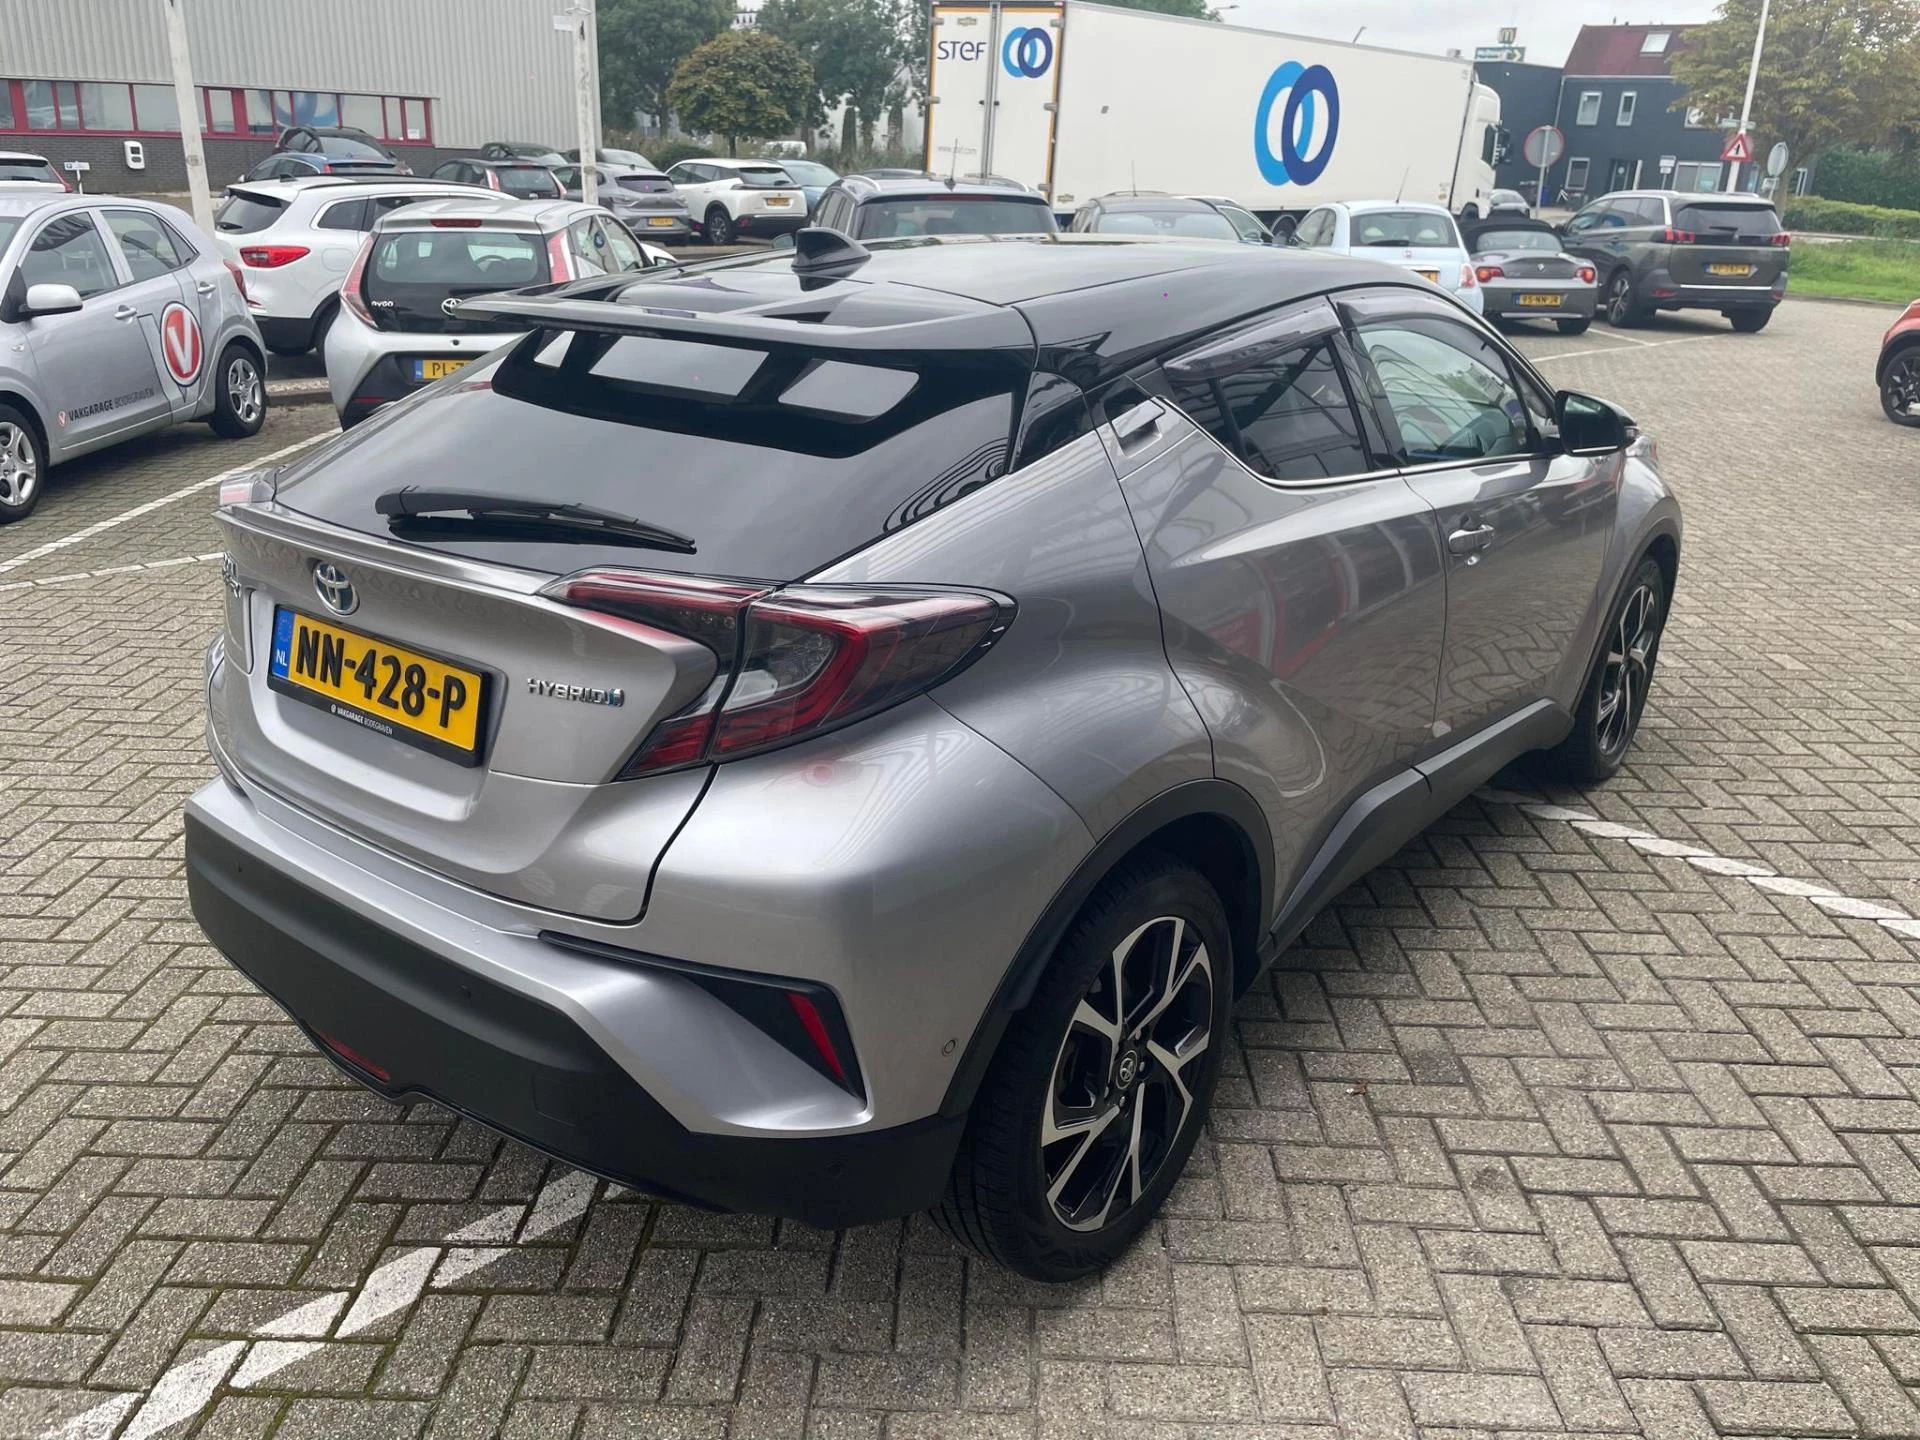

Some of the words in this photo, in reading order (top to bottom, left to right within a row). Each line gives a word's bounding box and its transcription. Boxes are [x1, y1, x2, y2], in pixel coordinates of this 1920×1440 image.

[68, 400, 114, 421] VAKGARAGE
[276, 649, 288, 667] NL
[296, 625, 467, 728] NN-428-P
[527, 678, 609, 705] HYBRID
[337, 707, 364, 724] VAKGARAGE
[364, 717, 393, 735] BODEGRAVEN
